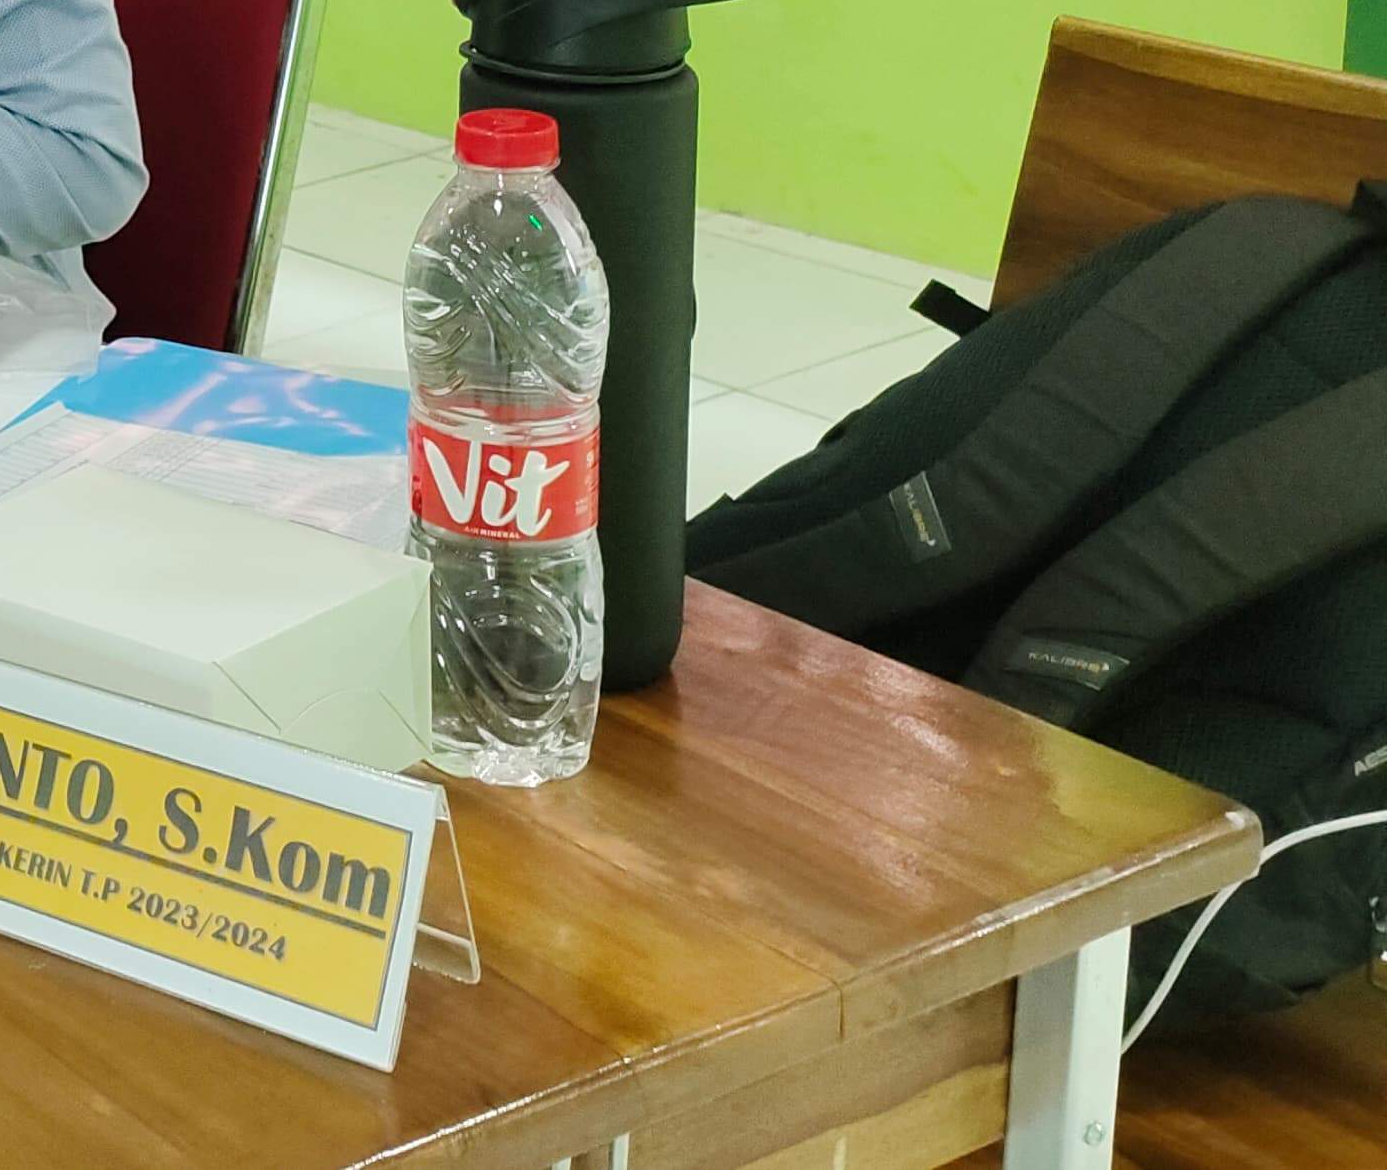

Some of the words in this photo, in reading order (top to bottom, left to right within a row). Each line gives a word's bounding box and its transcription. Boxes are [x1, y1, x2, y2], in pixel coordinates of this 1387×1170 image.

[422, 436, 570, 537] Vit
[480, 529, 521, 539] MINERAL
[158, 787, 392, 920] S.Kom
[80, 868, 121, 903] T.P
[126, 886, 287, 962] 2023/2024
